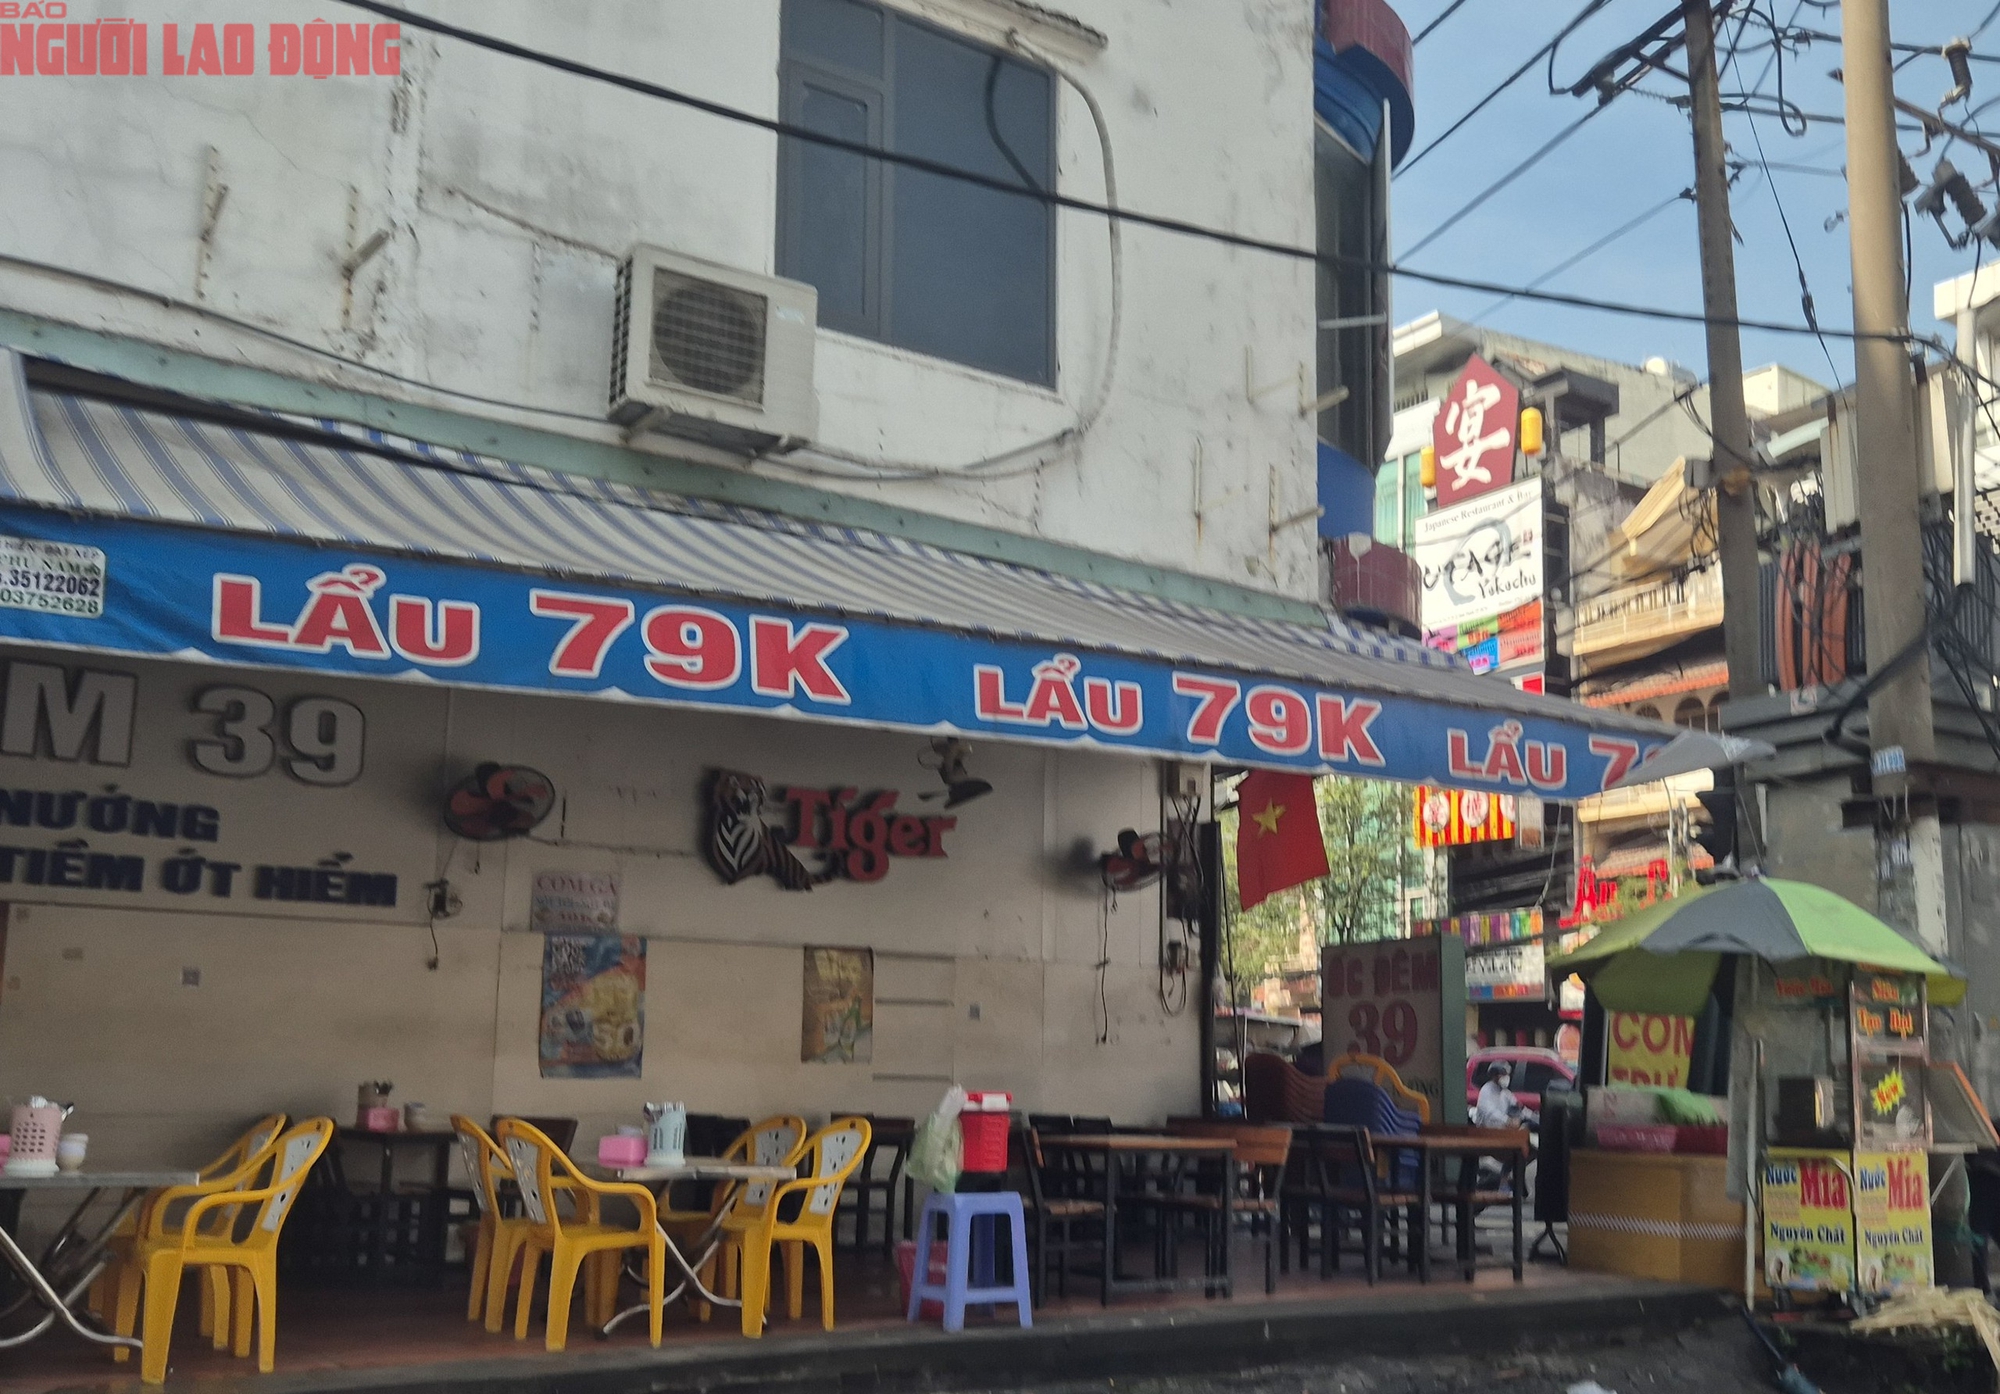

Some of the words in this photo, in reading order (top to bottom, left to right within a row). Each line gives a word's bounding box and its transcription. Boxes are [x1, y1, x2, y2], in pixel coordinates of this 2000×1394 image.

[1440, 379, 1511, 491] 宴
[1424, 514, 1460, 533] Japanese
[1460, 497, 1505, 521] Restaurant
[213, 563, 480, 667] LẨU
[530, 588, 851, 705] 79K
[973, 652, 1143, 736] LẨU
[1172, 670, 1386, 766] 79K
[1447, 718, 1567, 790] LẨU
[1589, 733, 1665, 793] 7
[0, 659, 138, 768] M
[190, 684, 366, 788] 39
[786, 785, 958, 883] Tiger
[160, 847, 241, 899] ỚT
[253, 850, 397, 907] HIỂM
[1347, 1000, 1418, 1067] 39
[1798, 1157, 1847, 1210] Mía
[1887, 1156, 1925, 1211] Mía
[1770, 1221, 1813, 1243] Nguyên
[1817, 1222, 1846, 1246] Chất
[1865, 1228, 1900, 1248] Nguyên
[1902, 1226, 1924, 1245] Chất
